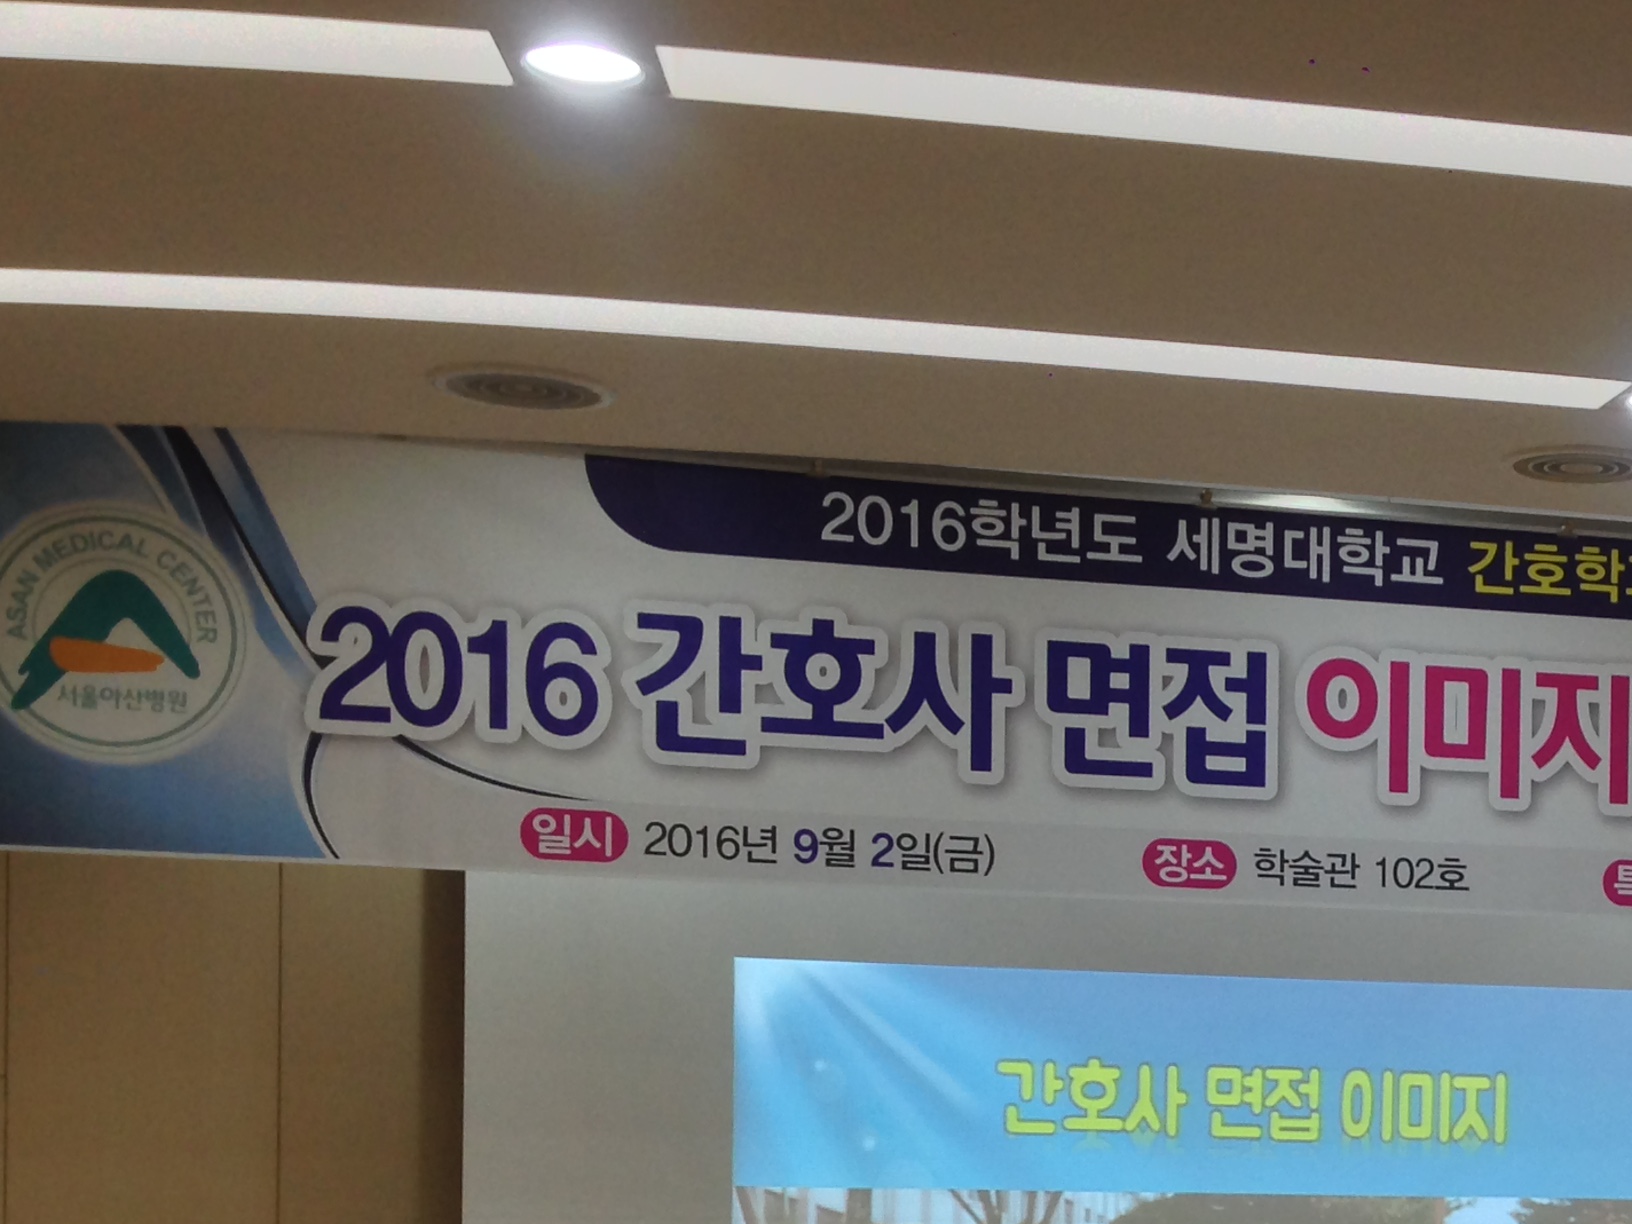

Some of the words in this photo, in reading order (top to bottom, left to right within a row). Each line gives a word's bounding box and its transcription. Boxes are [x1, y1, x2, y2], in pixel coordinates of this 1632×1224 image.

[820, 491, 1143, 566] 2016학년도
[1167, 514, 1445, 588] 세명대학교
[7, 569, 41, 641] ASAN
[33, 530, 150, 572] MEDICAL
[156, 550, 219, 644] CENTER
[57, 684, 189, 715] 서울아산병원
[318, 604, 600, 738] 2016
[635, 612, 1012, 773] 간호사
[1046, 638, 1268, 790] 면접
[1306, 656, 1630, 805] 이미지
[532, 813, 614, 857] 일시
[644, 821, 778, 865] 2016년
[793, 826, 856, 869] 9월
[871, 831, 996, 877] 2일(금)
[1153, 844, 1228, 883] 장소
[1253, 847, 1361, 889] 학술관
[1376, 856, 1470, 891] 102호
[995, 1057, 1187, 1137] 간호사
[1205, 1064, 1321, 1142] 면접
[1340, 1069, 1508, 1145] 이미지
